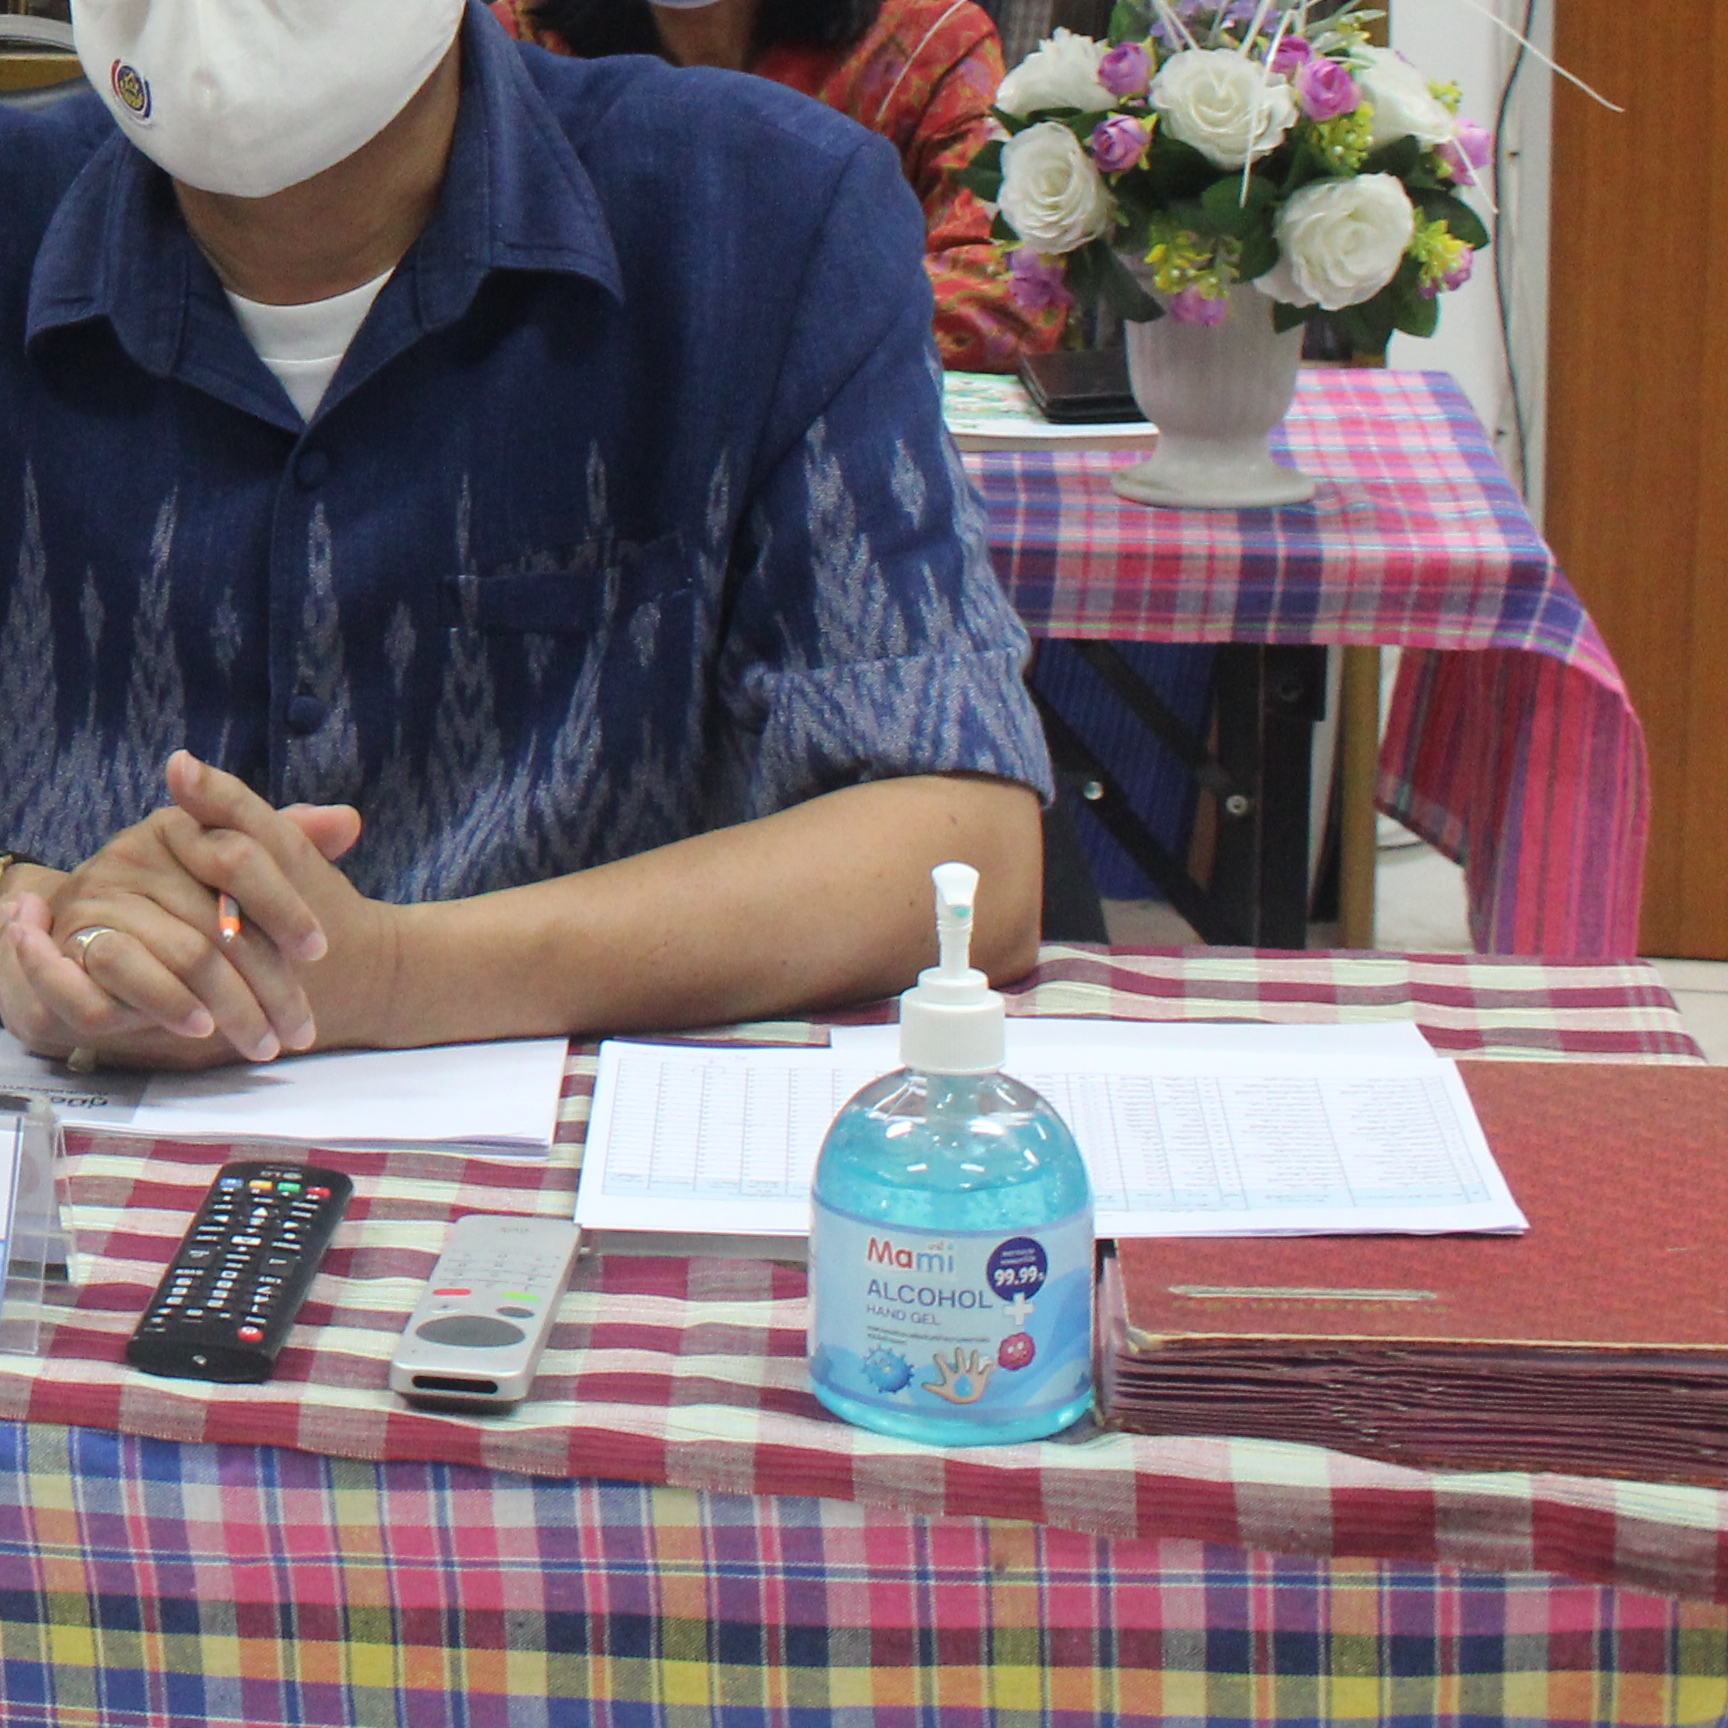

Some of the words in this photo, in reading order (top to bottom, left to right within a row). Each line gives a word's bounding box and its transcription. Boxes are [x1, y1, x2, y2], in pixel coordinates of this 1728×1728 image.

[867, 1236, 955, 1273] Mami
[867, 1278, 993, 1309] ALCOHOL
[866, 1304, 907, 1322] HAND
[911, 1311, 942, 1326] GEL
